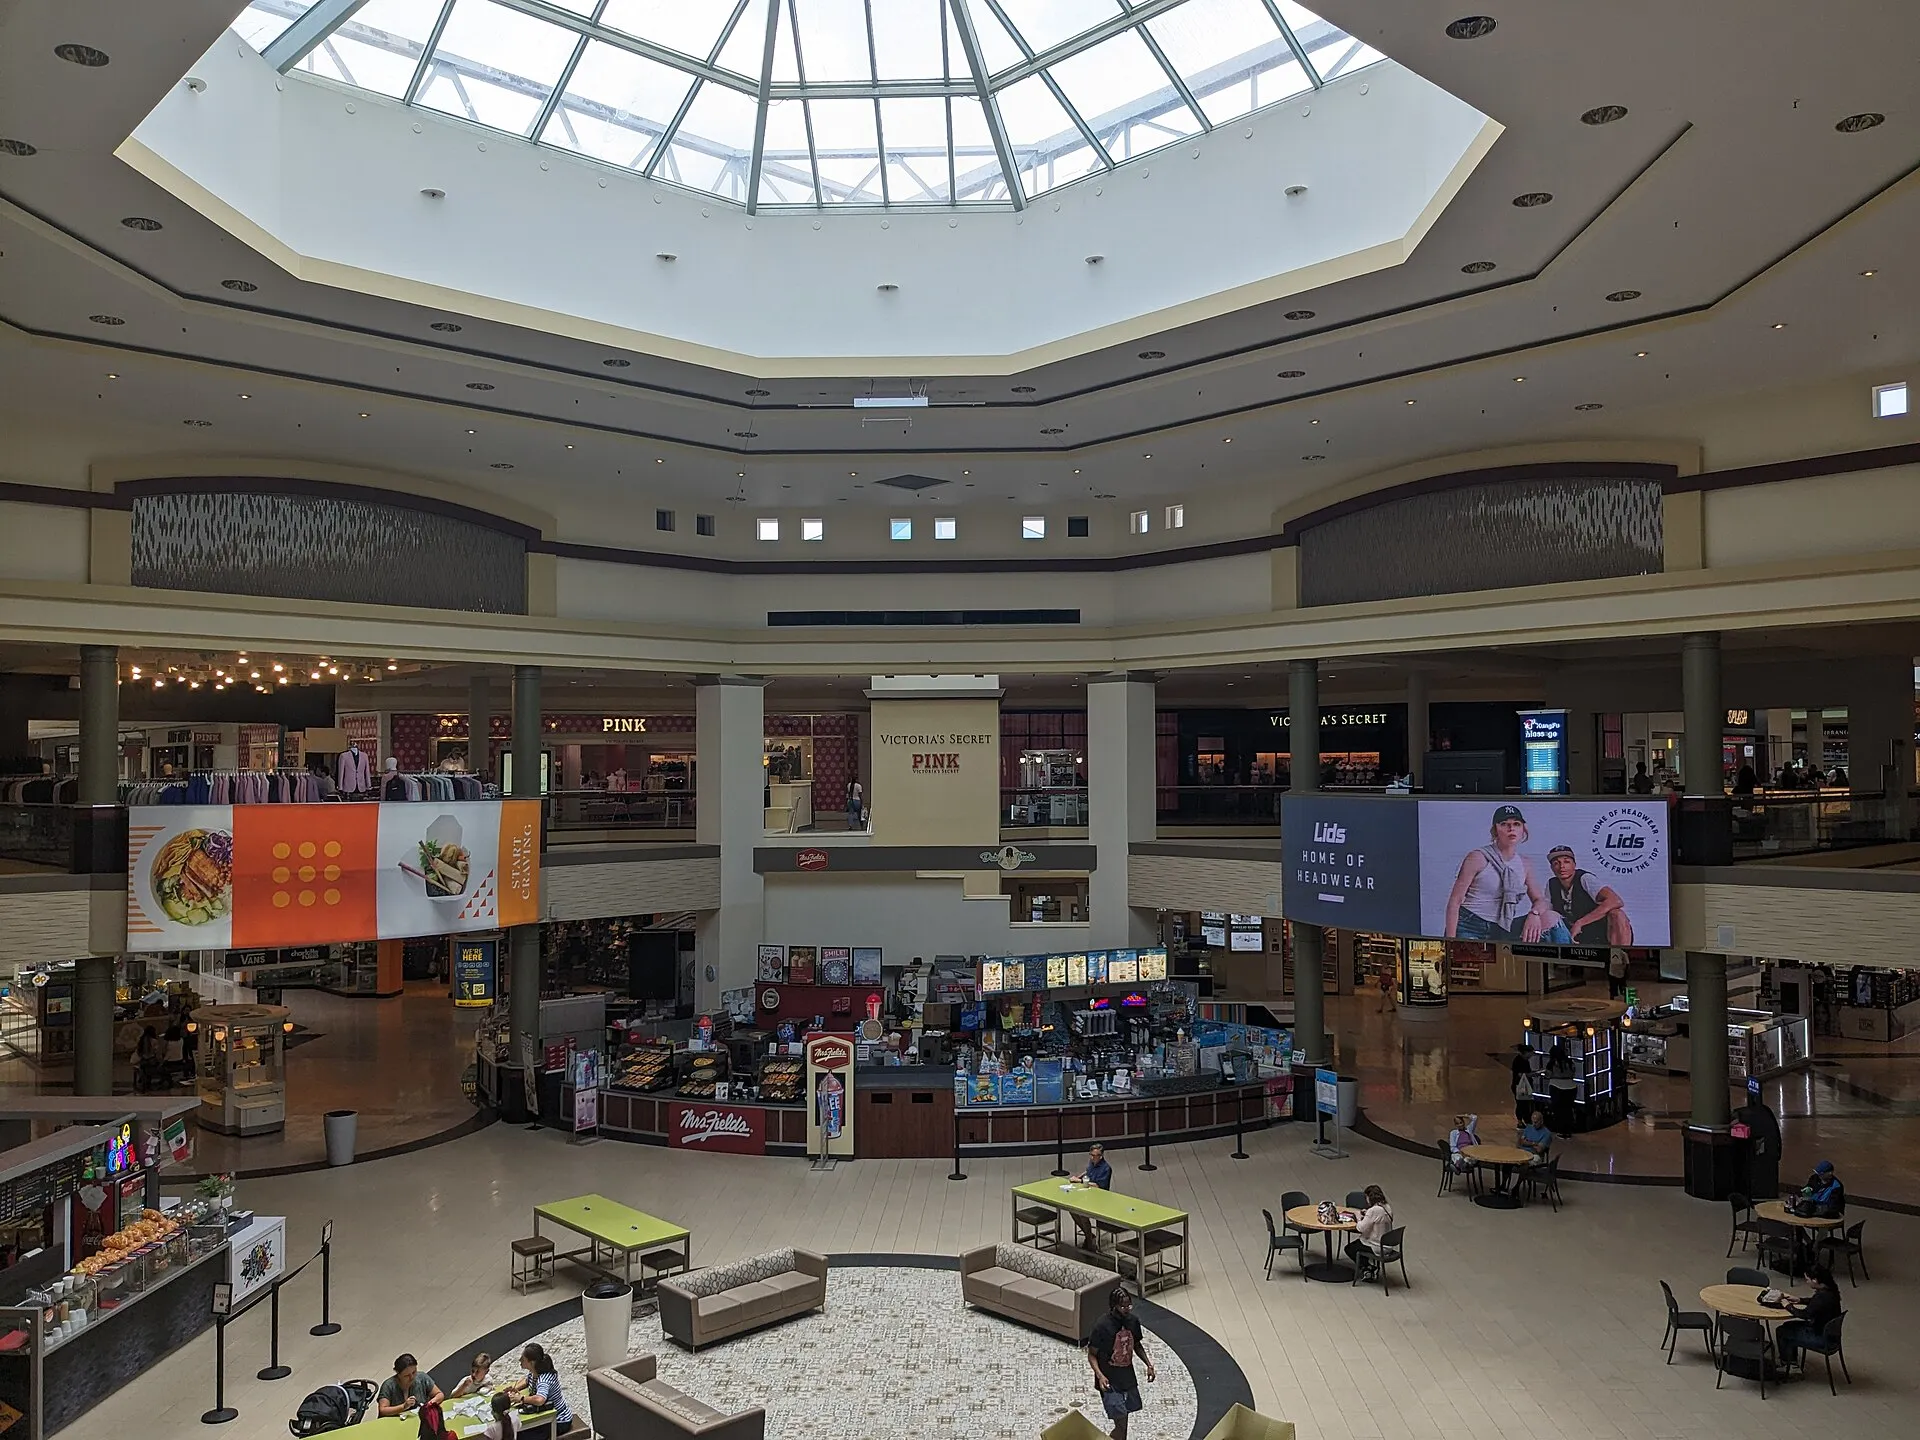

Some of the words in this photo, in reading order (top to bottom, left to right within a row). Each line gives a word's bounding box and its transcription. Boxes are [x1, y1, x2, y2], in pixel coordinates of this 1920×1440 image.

[602, 718, 647, 732] PINK
[1270, 715, 1337, 727] VICA'S
[1341, 714, 1387, 725] SECRET
[880, 734, 945, 744] VICTORIA'S
[949, 733, 992, 744] SECRET
[912, 753, 960, 769] PINK
[1592, 815, 1607, 835] HOME
[1608, 809, 1618, 818] OF
[1621, 808, 1659, 835] HEADWEAR
[1313, 822, 1346, 844] Lids
[1605, 833, 1645, 849] Lids
[511, 836, 522, 889] START
[521, 824, 532, 900] CRAVING
[1302, 850, 1335, 865] HOME
[1346, 854, 1364, 868] OF
[1592, 847, 1610, 868] STYLE
[1611, 865, 1633, 874] FROM
[1635, 861, 1650, 872] THE
[1648, 847, 1659, 861] TOP
[1297, 869, 1374, 890] HEADWEAR
[240, 952, 266, 965] VANS
[680, 1109, 708, 1129] Mrs.
[702, 1110, 750, 1140] Fields
